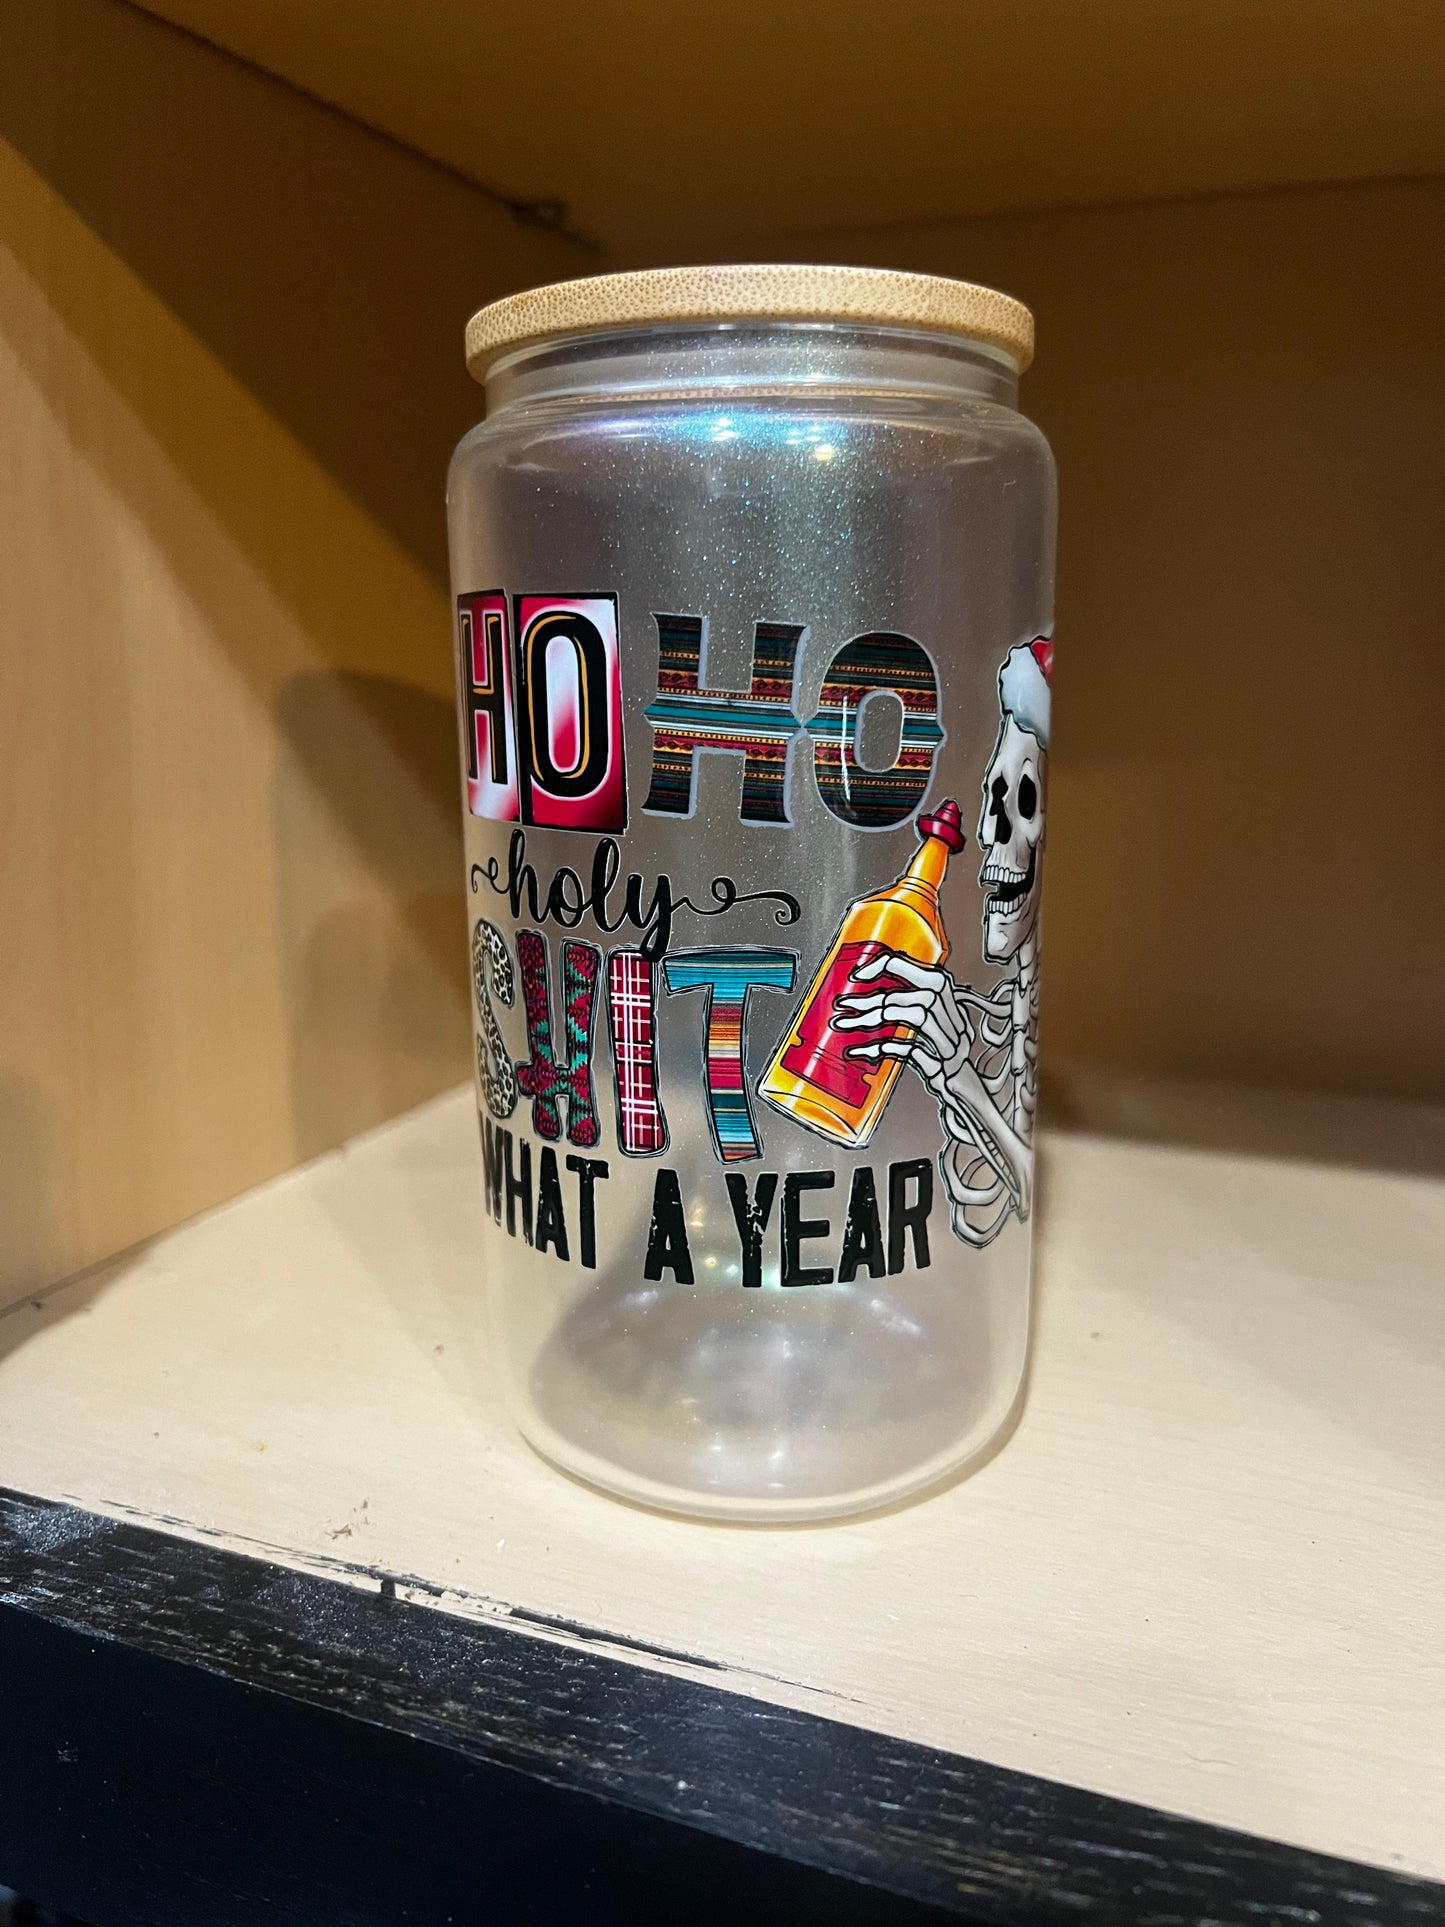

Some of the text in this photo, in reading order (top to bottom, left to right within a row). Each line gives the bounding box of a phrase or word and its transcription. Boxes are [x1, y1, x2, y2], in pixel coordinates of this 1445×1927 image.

[459, 594, 946, 833] HO HO
[471, 829, 801, 963] holy
[473, 919, 801, 1165] SHIT
[479, 1110, 933, 1287] WHAT A YEAR
